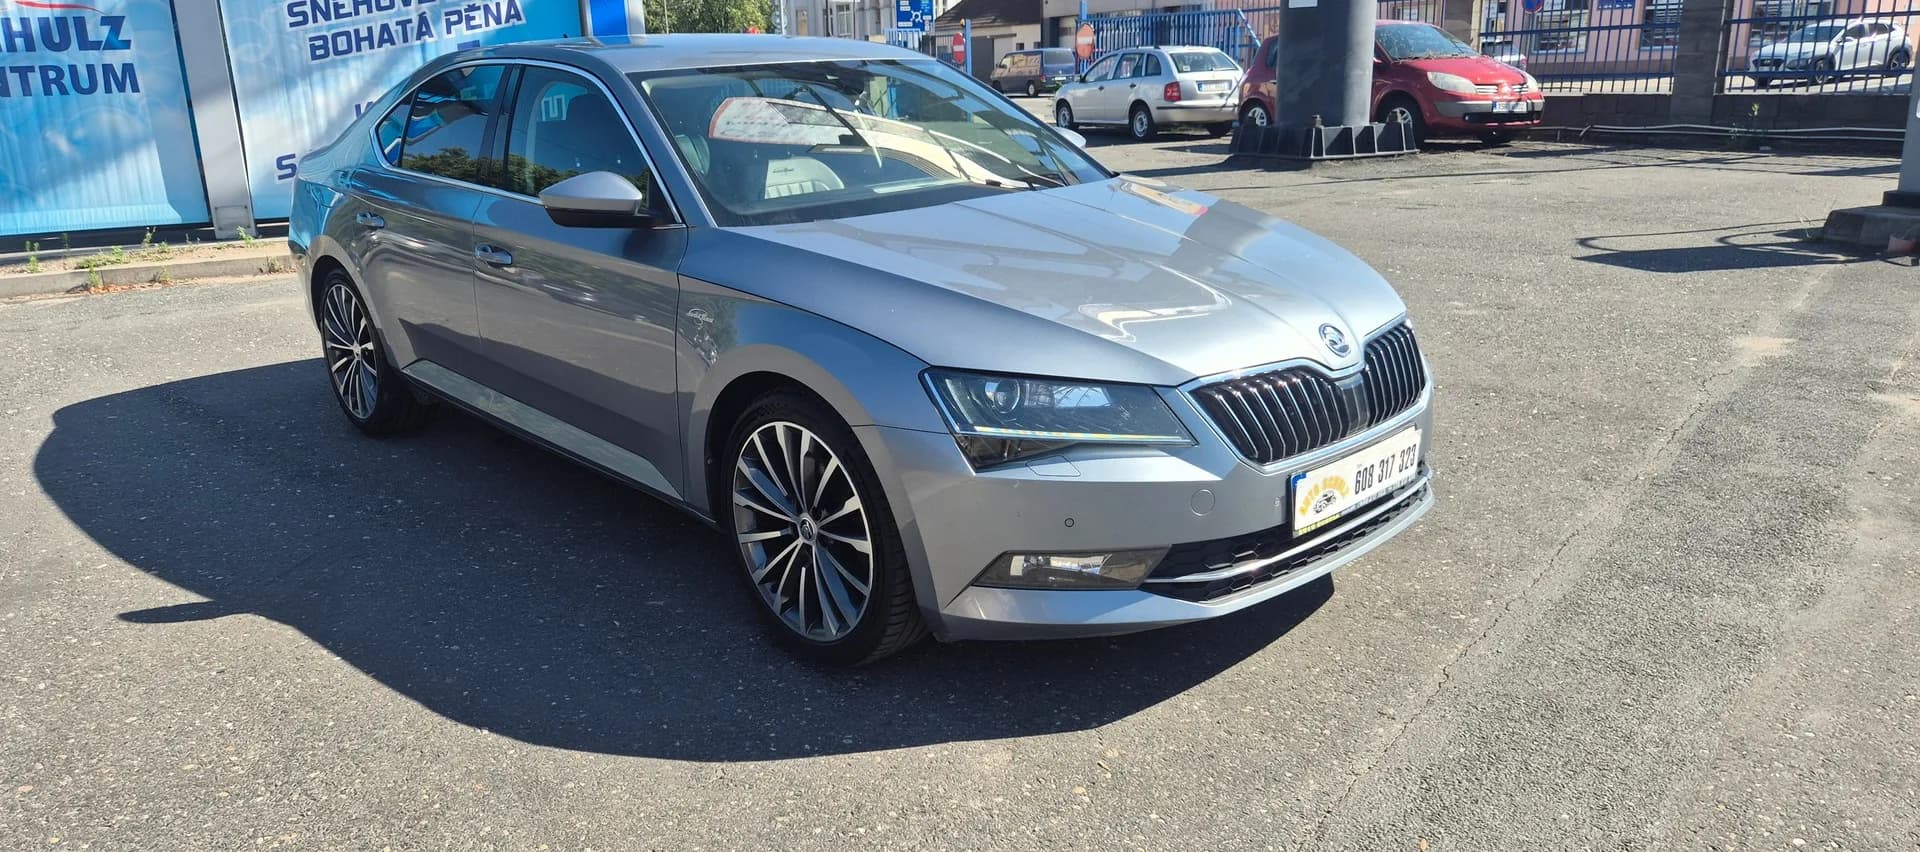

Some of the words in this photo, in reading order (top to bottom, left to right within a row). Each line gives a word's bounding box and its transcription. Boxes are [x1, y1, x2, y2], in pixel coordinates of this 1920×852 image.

[0, 15, 132, 53] HULZ
[308, 12, 434, 61] BOHATÁ
[444, 0, 523, 35] PĚNA
[1354, 464, 1375, 495] 608
[1378, 453, 1396, 483] 317
[1398, 443, 1417, 473] 323
